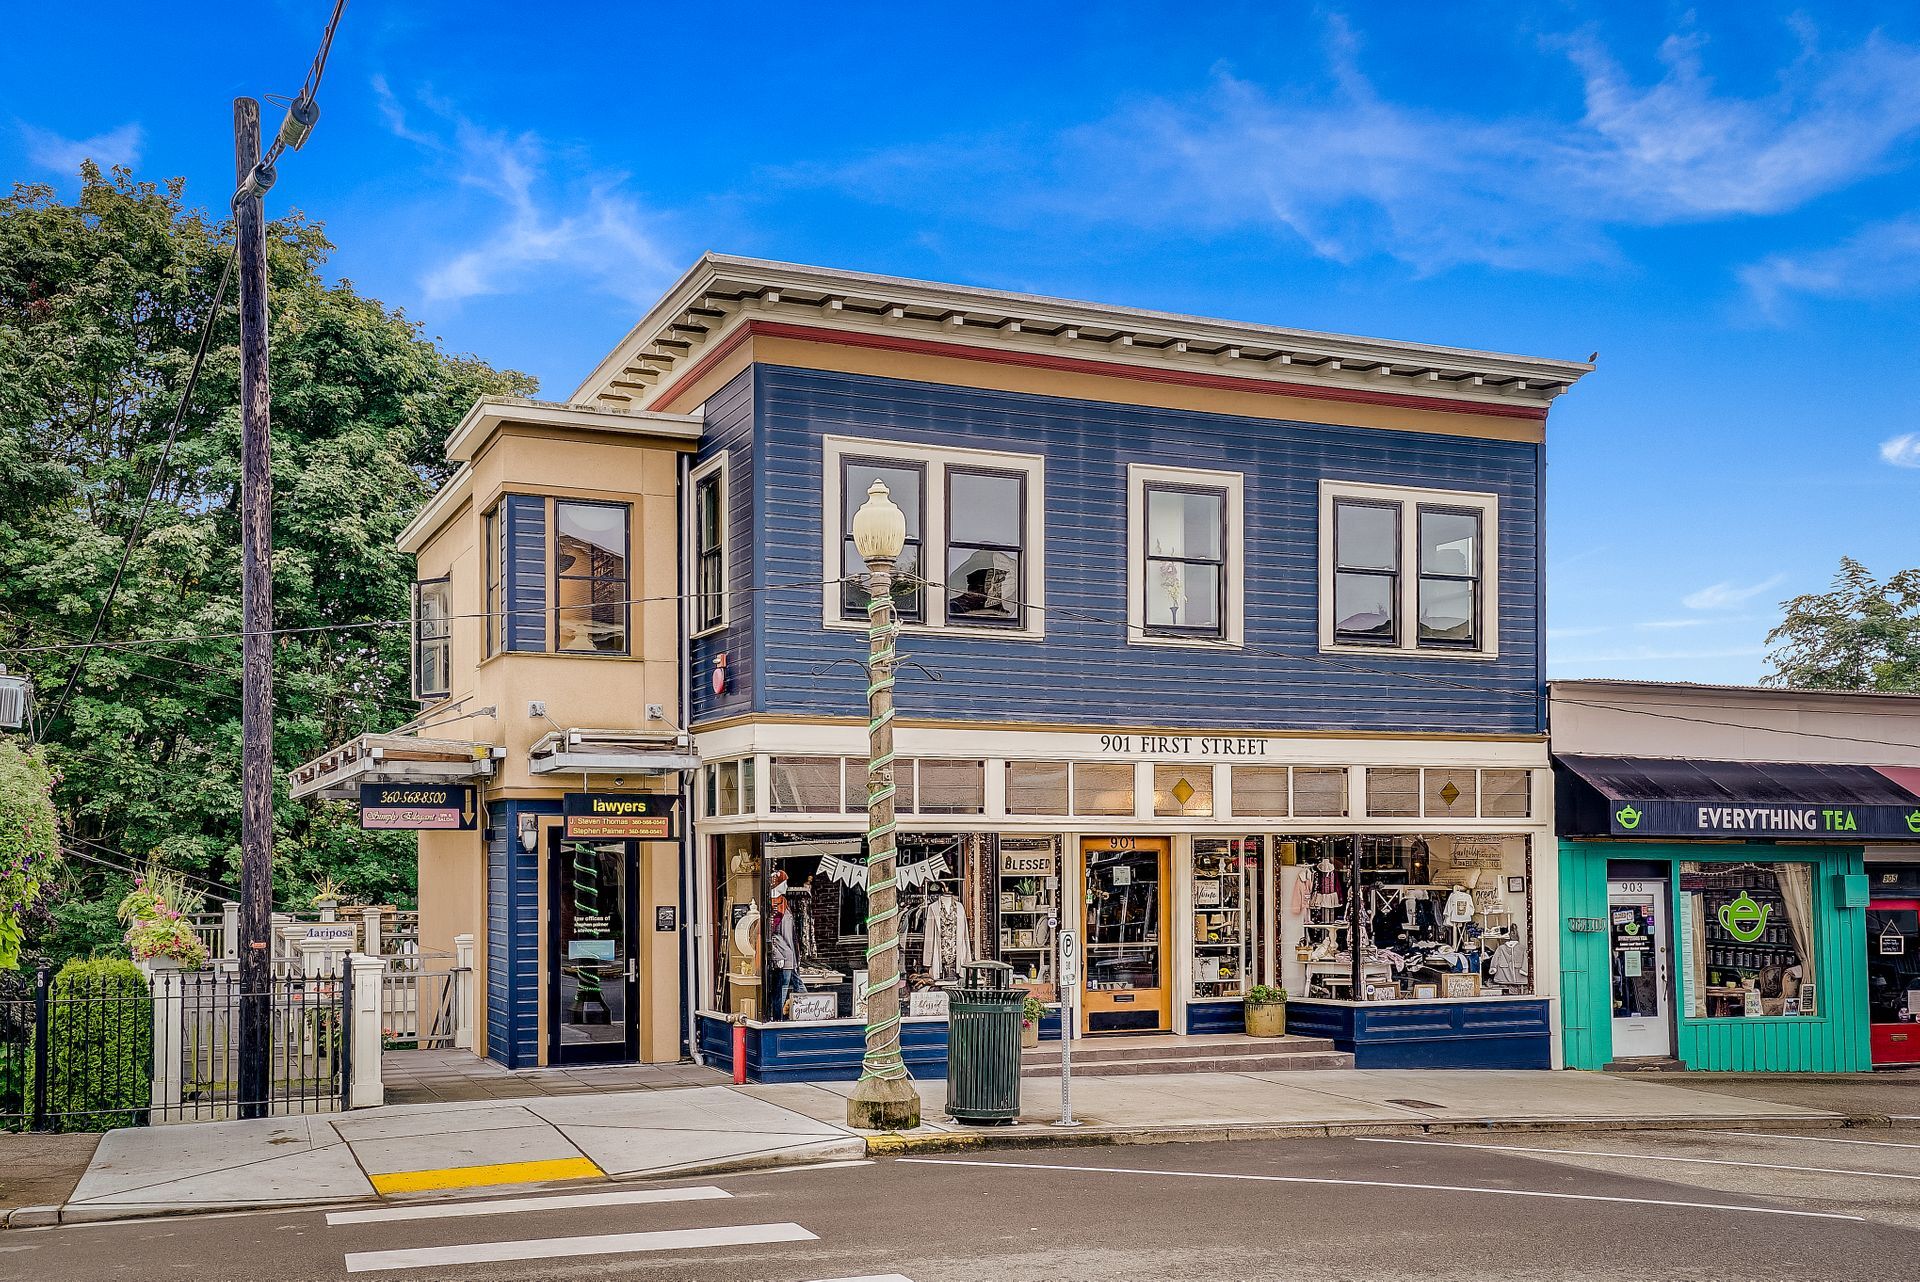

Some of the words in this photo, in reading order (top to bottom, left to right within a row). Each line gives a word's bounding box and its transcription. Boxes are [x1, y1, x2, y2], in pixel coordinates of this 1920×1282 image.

[1100, 735, 1131, 752] 901
[1140, 736, 1192, 754] FIRST
[1201, 737, 1269, 755] STREET
[380, 790, 447, 804] 360-568-8500
[593, 799, 647, 815] lawyers
[1698, 807, 1817, 830] EVERYTHING
[1822, 810, 1857, 831] TEA
[573, 827, 601, 835] Stephen
[1109, 836, 1137, 849] 901
[1004, 858, 1050, 871] BLESSED
[1621, 882, 1643, 893] 903
[794, 999, 832, 1020] grateful
